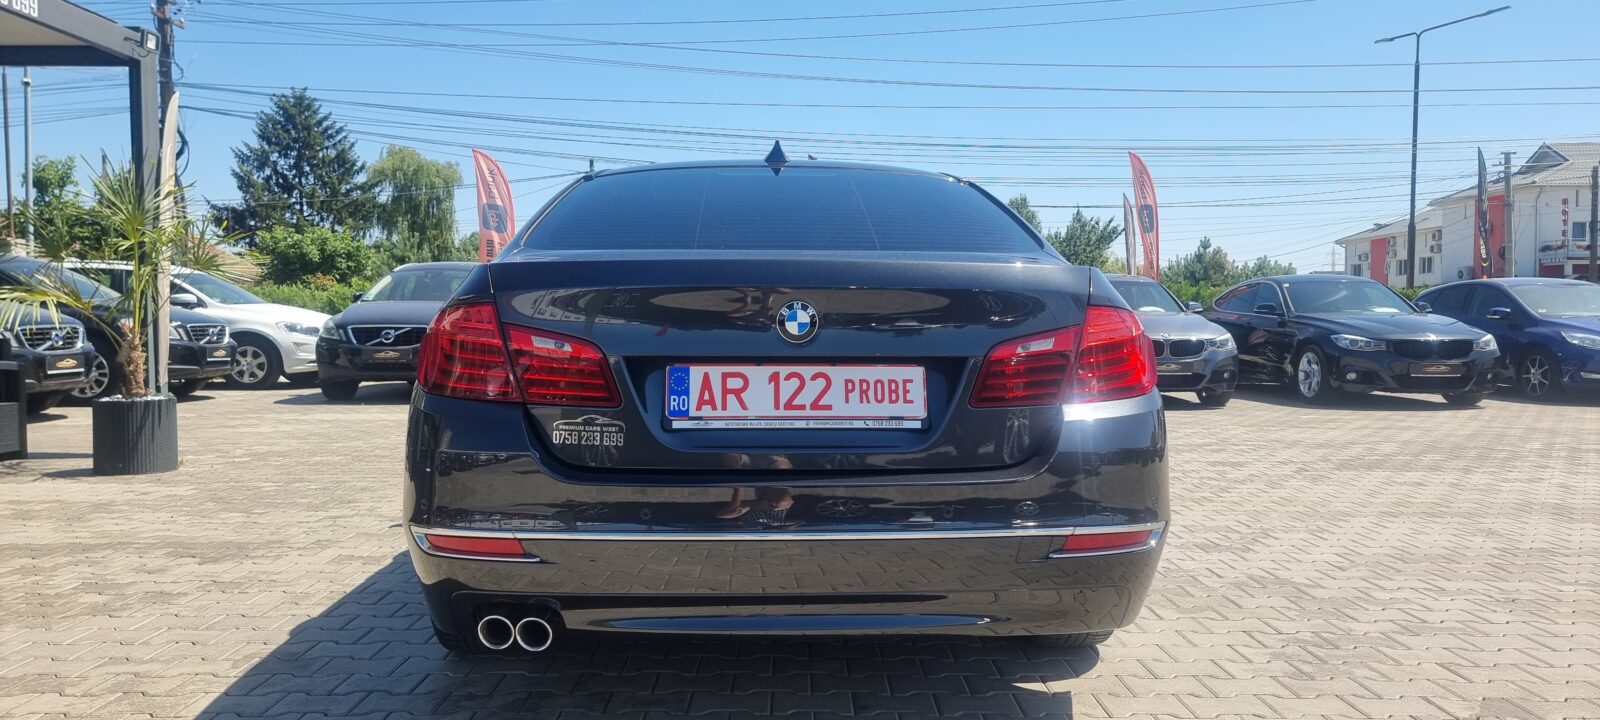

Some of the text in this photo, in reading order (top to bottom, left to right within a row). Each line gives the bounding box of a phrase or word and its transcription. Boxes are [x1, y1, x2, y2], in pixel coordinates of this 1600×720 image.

[780, 302, 816, 316] BMW
[670, 371, 914, 412] RO AR 122 PROBE
[552, 430, 624, 446] 0758 233 699
